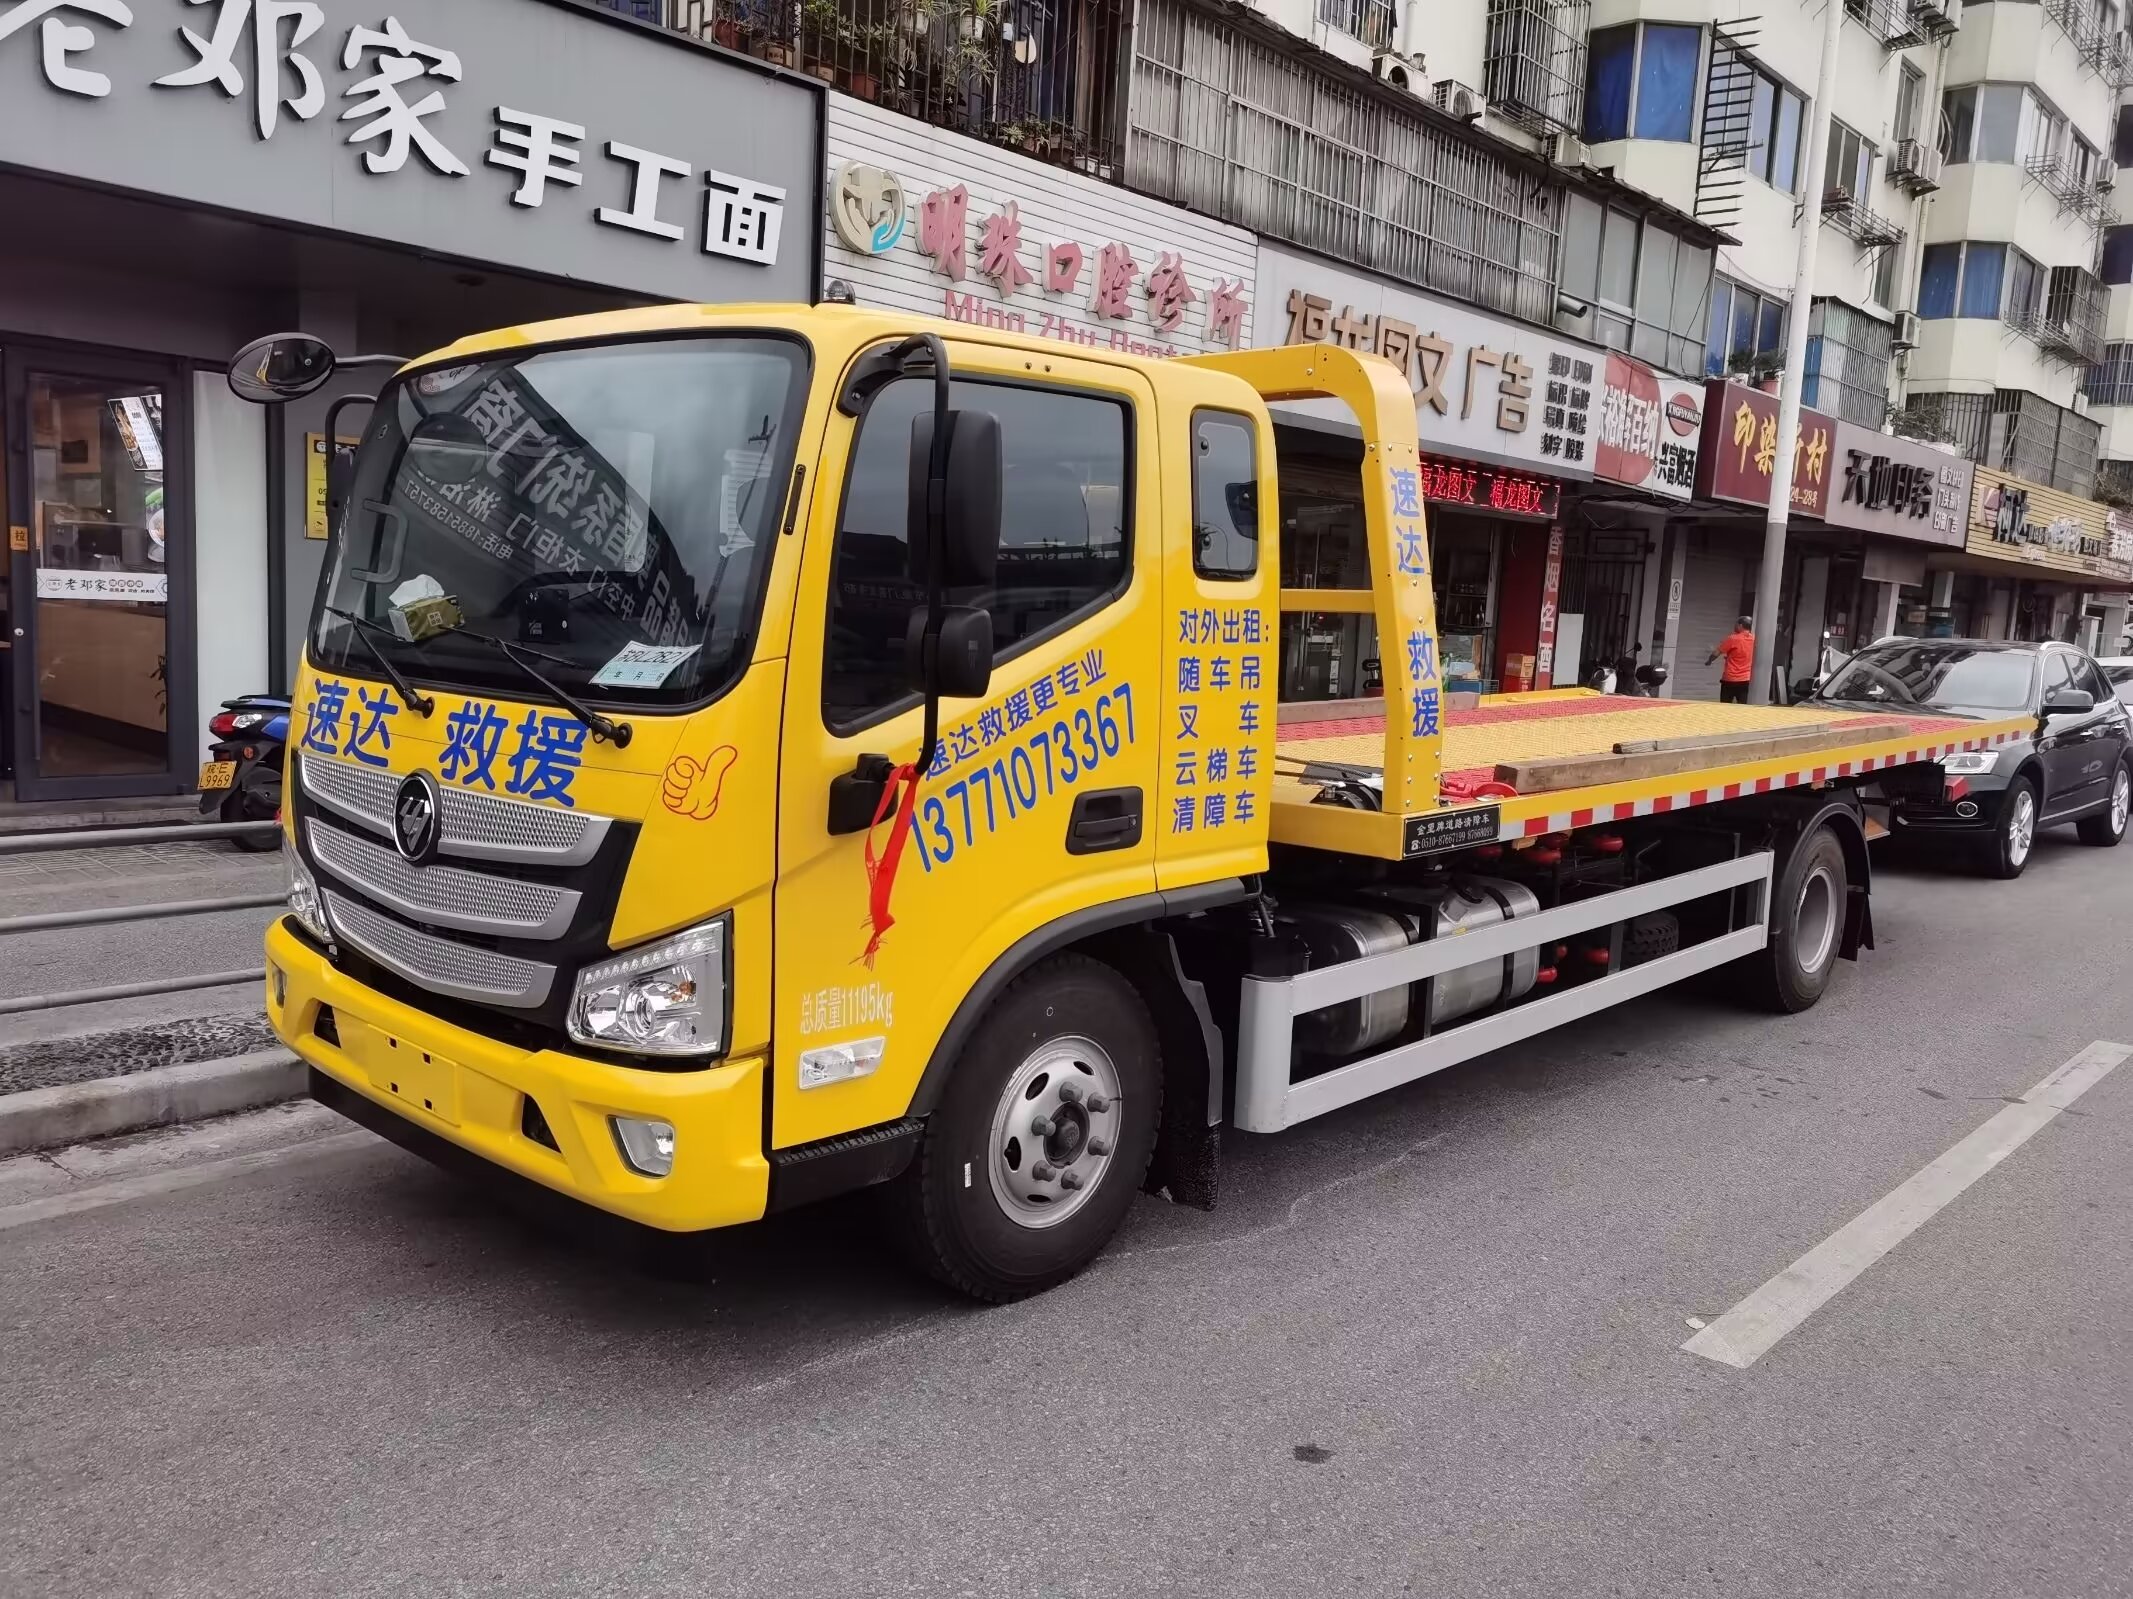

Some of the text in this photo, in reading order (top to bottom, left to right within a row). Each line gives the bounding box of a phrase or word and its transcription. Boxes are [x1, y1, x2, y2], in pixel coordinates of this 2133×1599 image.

[484, 105, 788, 268] 手工面
[914, 182, 1249, 351] 明珠口腔诊所
[1540, 432, 1563, 456] 刻字
[1490, 478, 1543, 511] 福龙图文
[65, 578, 108, 591] 老邓家
[1389, 465, 1440, 737] 速达 救援
[1537, 526, 1563, 672] 香烟名酒
[1179, 608, 1270, 645] 对外出租:
[1178, 656, 1261, 694] 随车吊
[302, 678, 593, 807] 速达 救援
[919, 648, 1107, 782] 速达救援更专业
[909, 682, 1136, 873] 13771073367
[1175, 747, 1258, 787] 云梯车
[1172, 789, 1255, 834] 清障车
[800, 980, 894, 1035] 总质量11195kg
